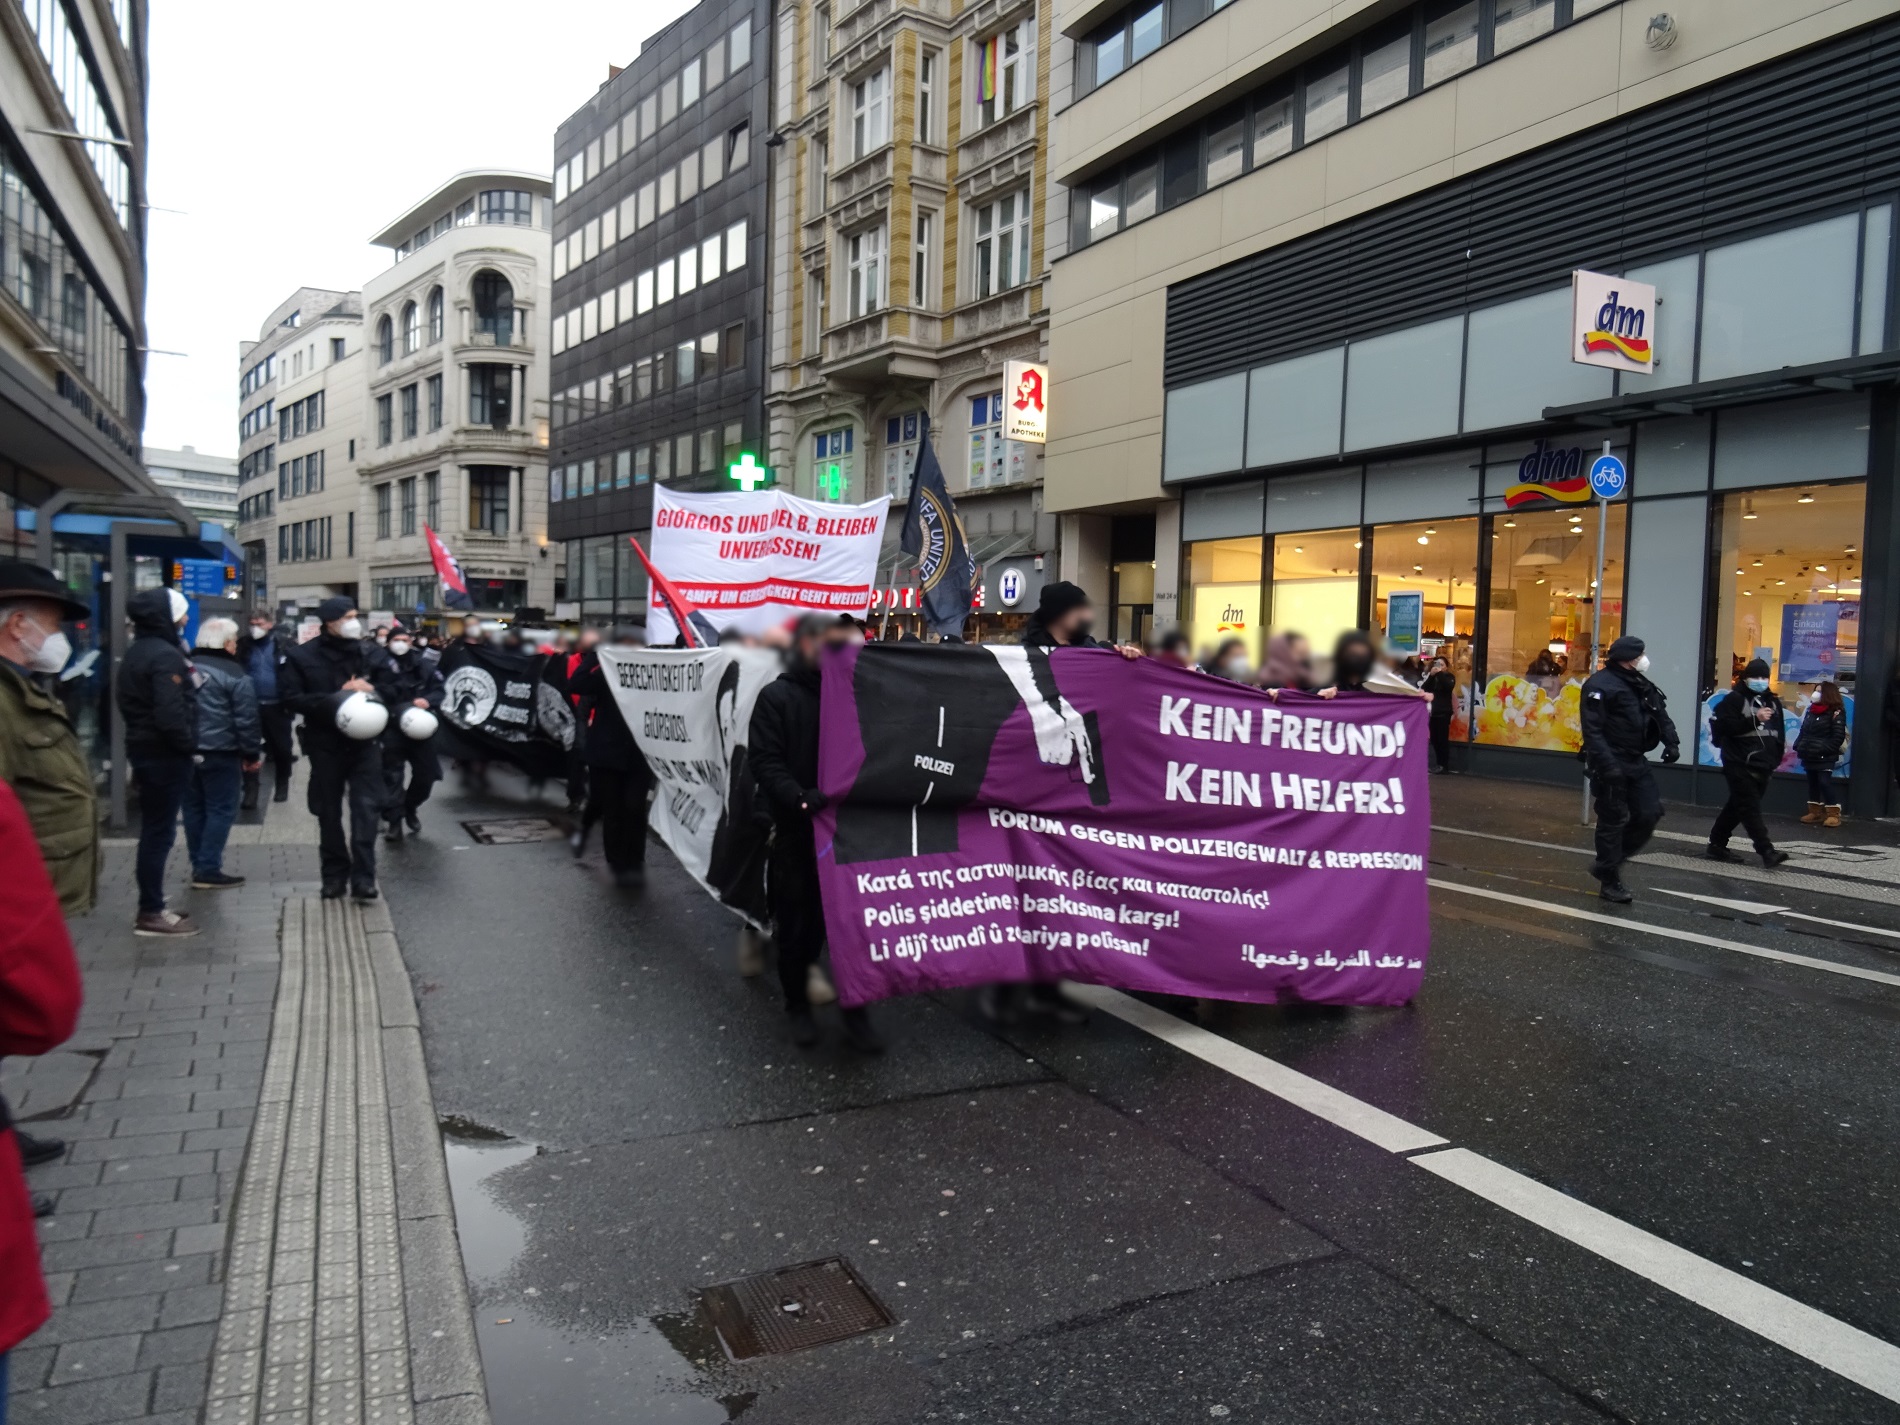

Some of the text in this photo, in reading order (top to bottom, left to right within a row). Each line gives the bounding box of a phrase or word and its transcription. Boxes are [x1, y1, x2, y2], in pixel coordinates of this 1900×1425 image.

[1595, 290, 1645, 338] dm
[1011, 428, 1045, 438] APOTHEKE
[1518, 438, 1584, 483] dm
[737, 514, 768, 534] UND
[797, 514, 810, 534] B.
[815, 516, 878, 536] BLEIBEN
[719, 590, 739, 604] UM
[800, 588, 829, 604] GEHT
[829, 590, 868, 606] WEITER!
[1222, 604, 1243, 622] dm
[1793, 620, 1825, 628] Einkauf
[617, 659, 704, 692] GERECHTIGKEIT FÜR
[1160, 695, 1406, 758] KEIN FREUND!
[914, 754, 955, 776] POLIZEI
[1165, 761, 1405, 815] KEIN HELFER!
[989, 807, 1423, 871] FORUM GEGEN POLIZEIGEWALT & REPRESSION
[857, 869, 914, 894] Κατά
[917, 867, 952, 890] της
[1072, 868, 1119, 895] βίας
[1121, 876, 1152, 893] και
[1156, 880, 1270, 910] καταστολής!
[864, 902, 916, 927] Polis
[1023, 893, 1116, 923] baskısına
[1119, 904, 1180, 930] karşı!
[869, 938, 890, 962] Li
[930, 927, 986, 954] tundî
[989, 922, 1003, 944] û
